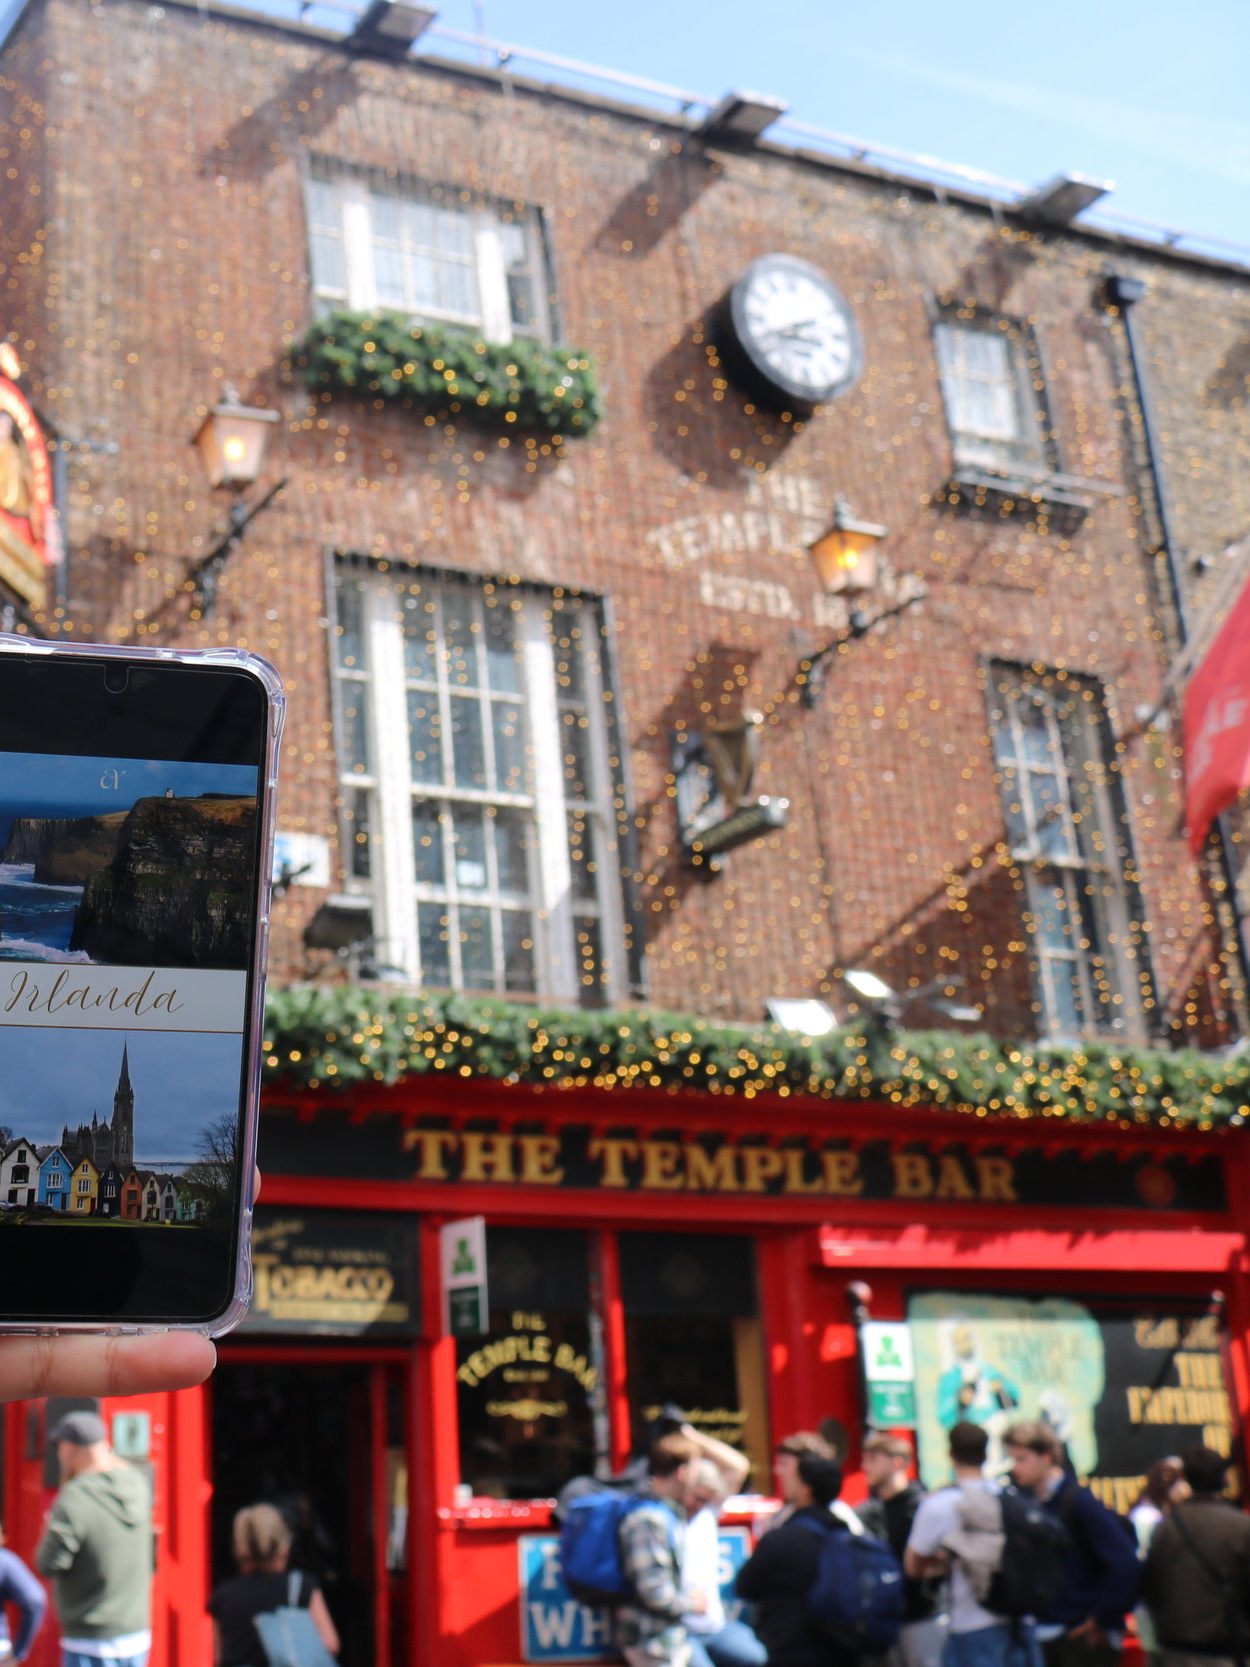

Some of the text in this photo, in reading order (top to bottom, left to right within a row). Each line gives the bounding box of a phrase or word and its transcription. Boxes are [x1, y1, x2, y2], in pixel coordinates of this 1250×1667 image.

[4, 968, 186, 1017] Irlanda
[403, 1128, 1019, 1201] THE TEMPLE BAR
[456, 1335, 552, 1388] TEMPLE
